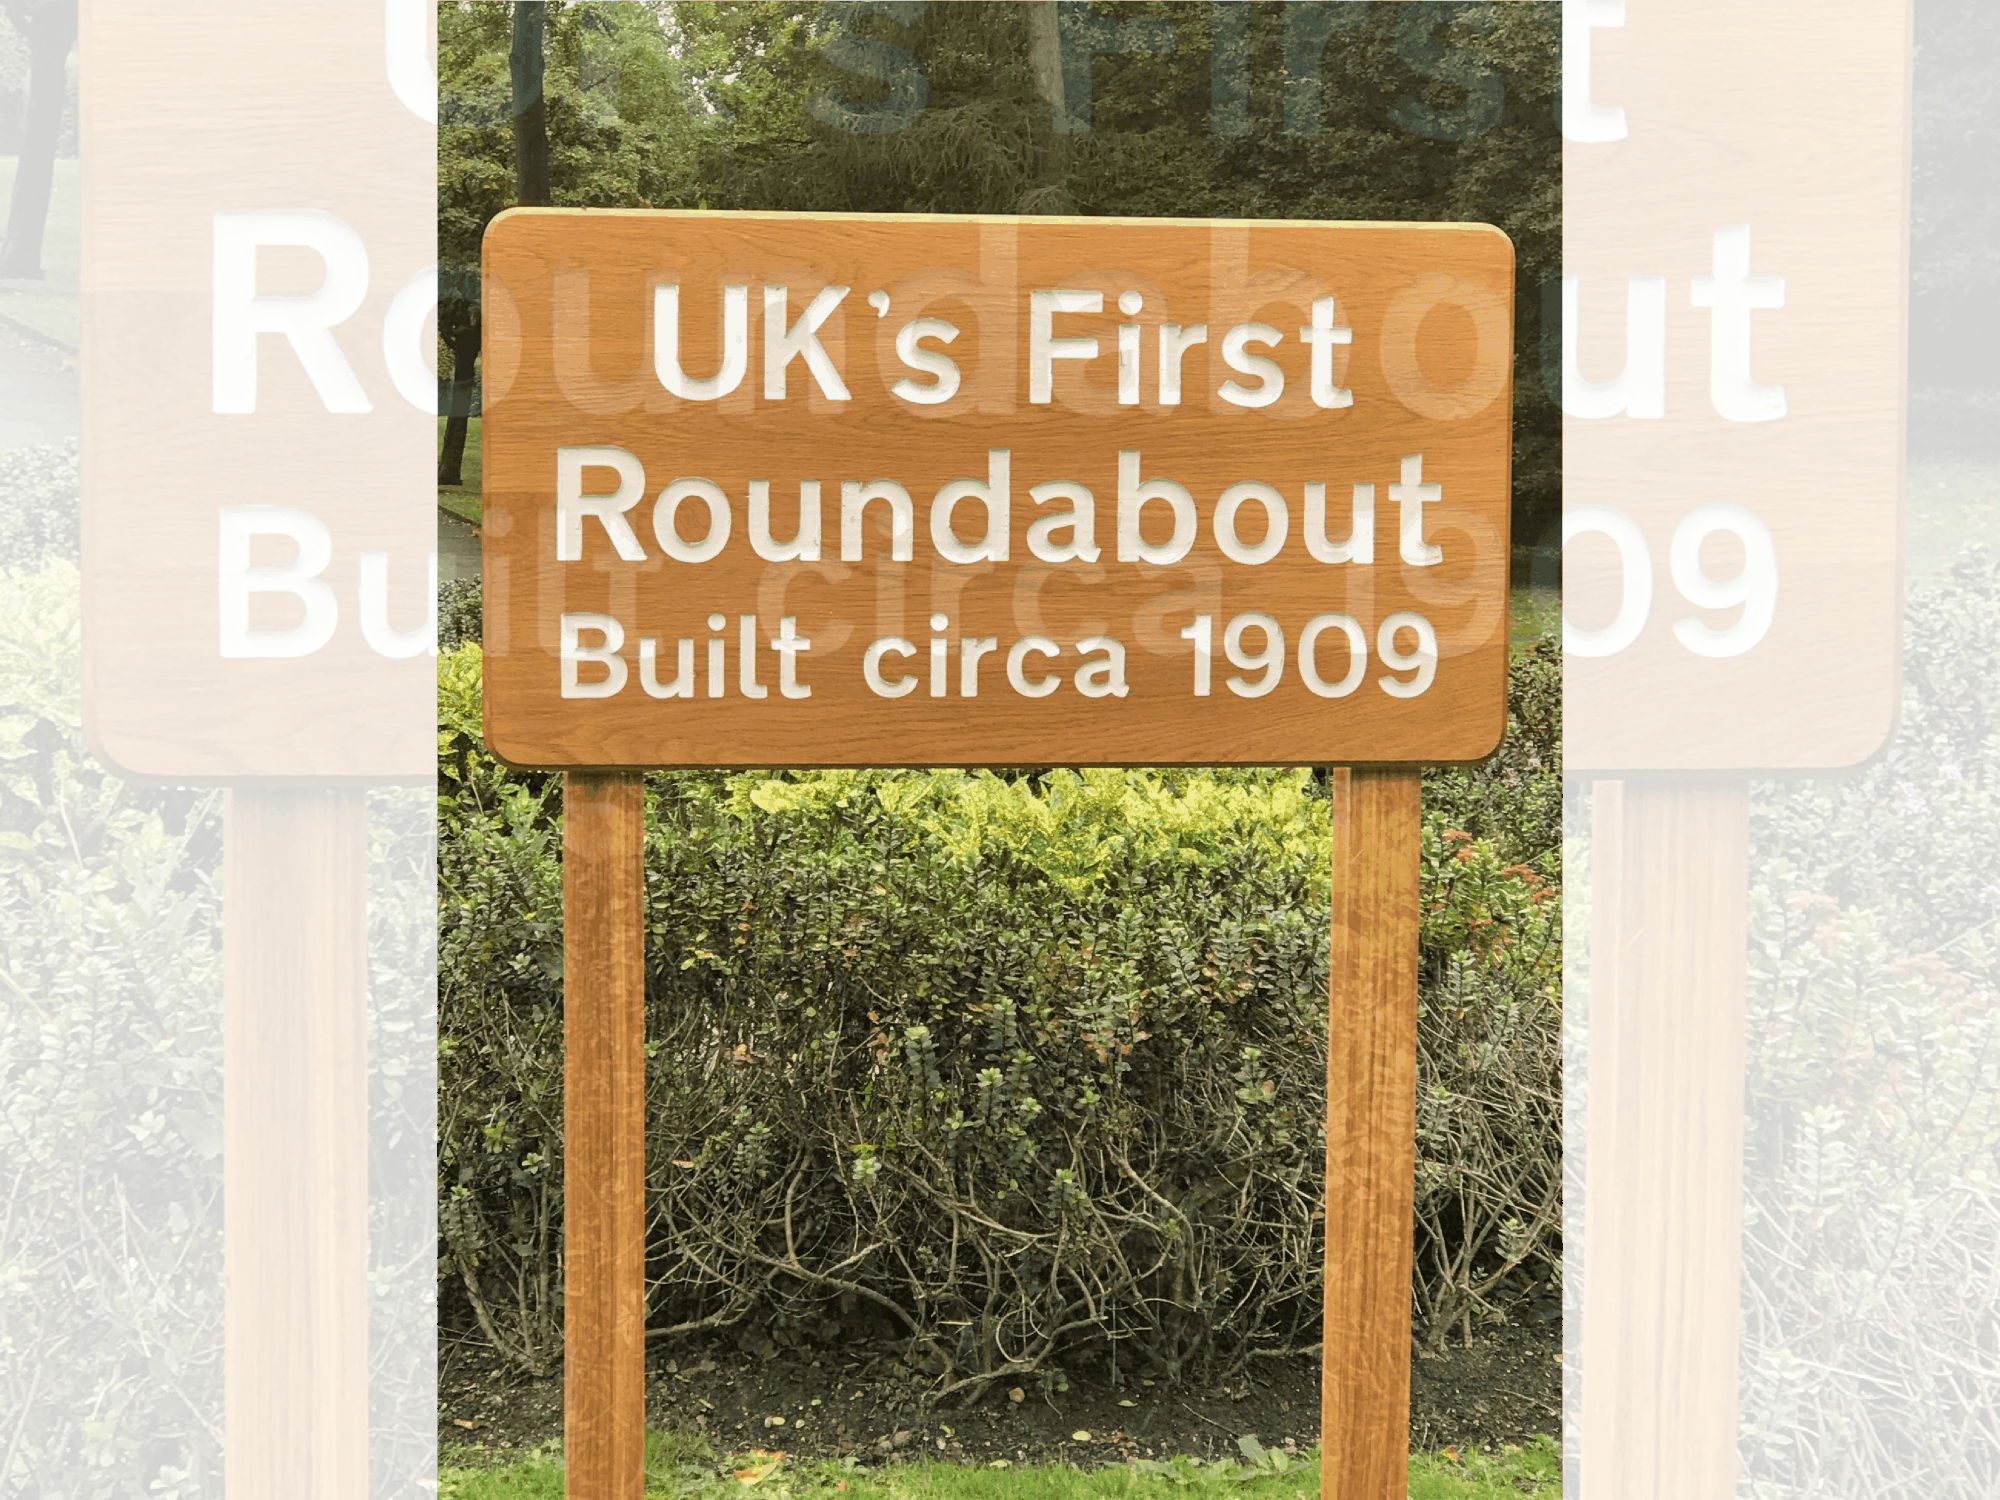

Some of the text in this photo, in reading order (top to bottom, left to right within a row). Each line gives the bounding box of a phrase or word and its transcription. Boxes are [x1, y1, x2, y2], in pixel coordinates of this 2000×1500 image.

[652, 283, 1354, 409] UK's First
[555, 444, 1444, 567] Roundabout
[558, 610, 1439, 700] Built circa 1909
